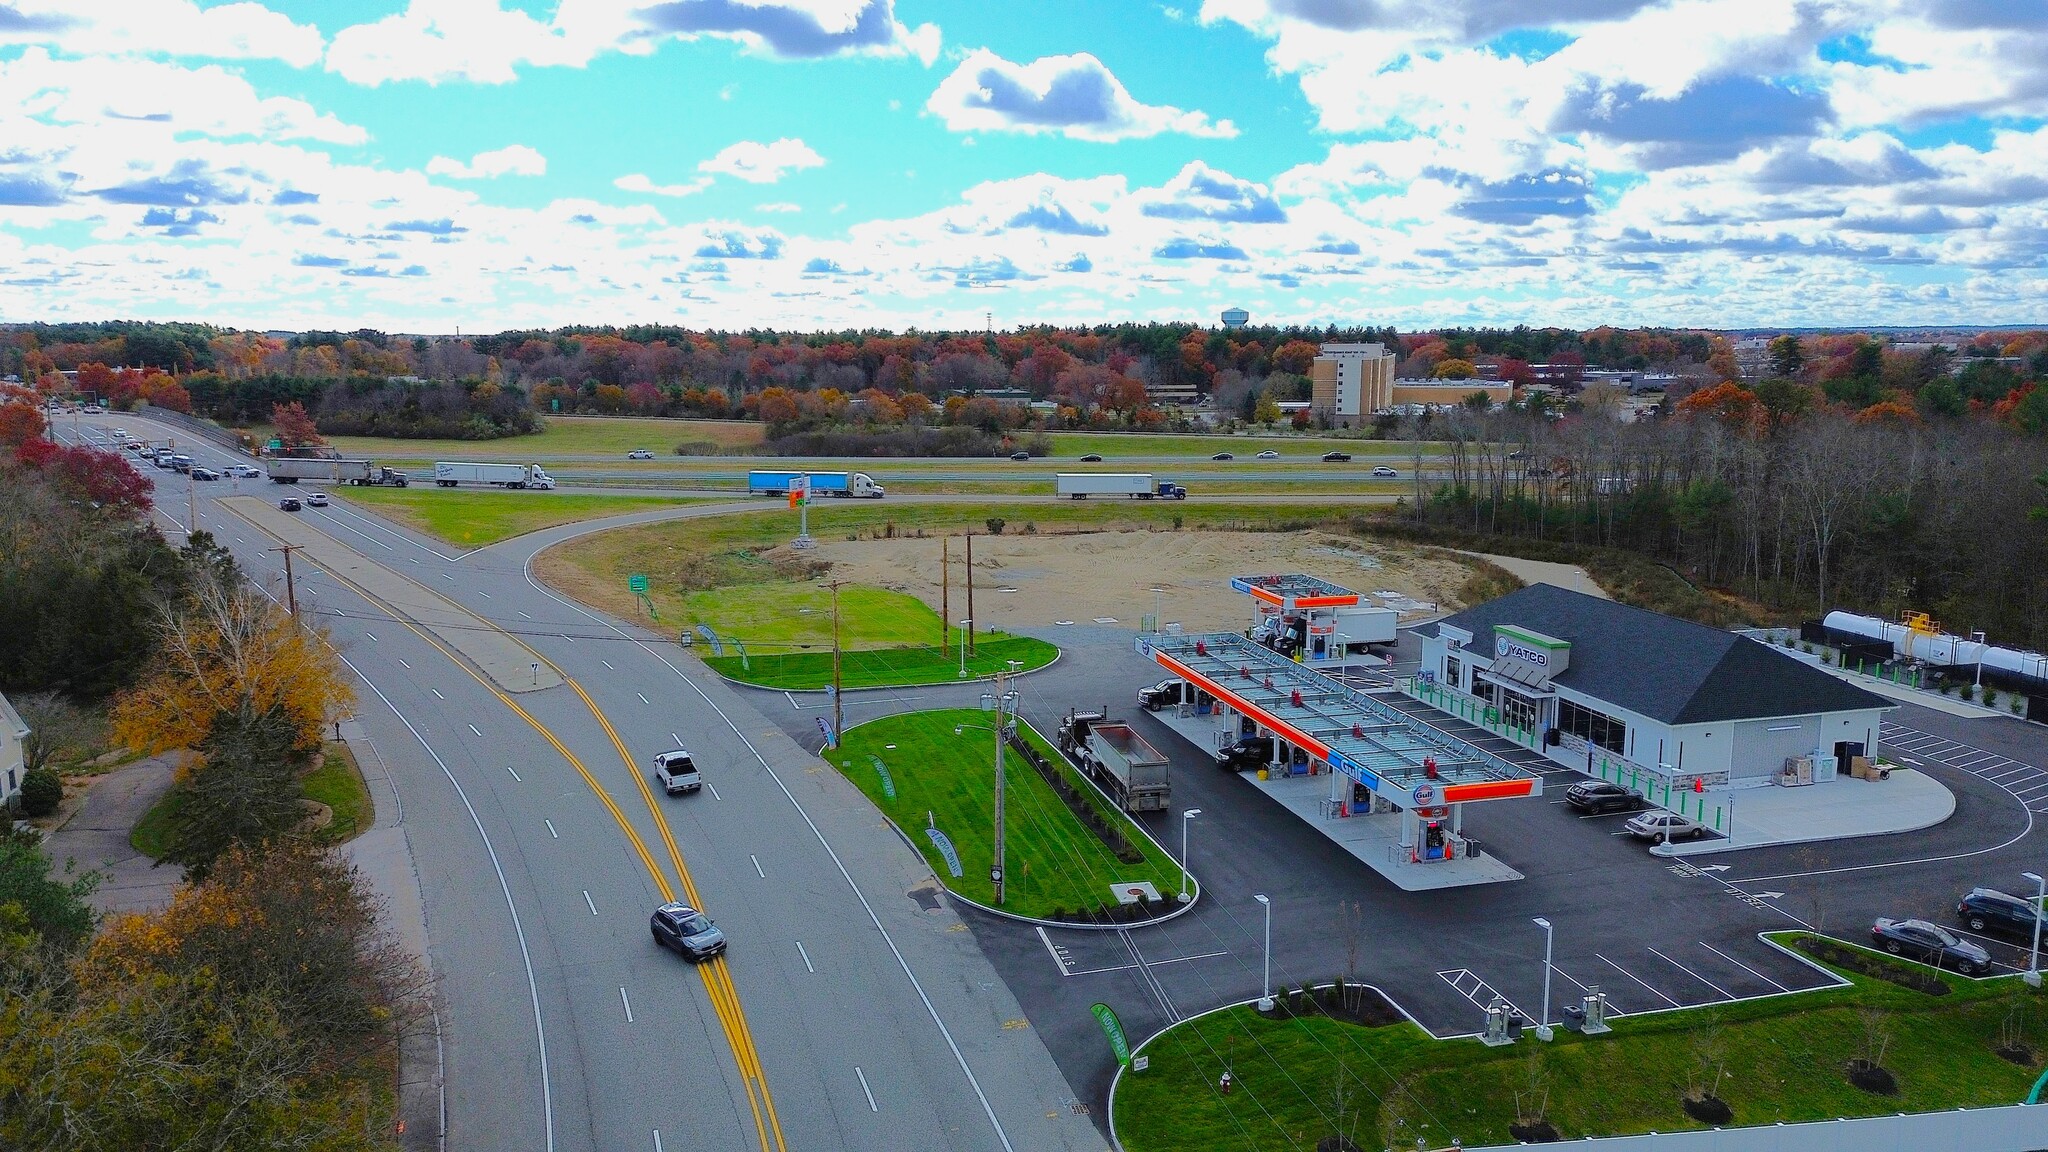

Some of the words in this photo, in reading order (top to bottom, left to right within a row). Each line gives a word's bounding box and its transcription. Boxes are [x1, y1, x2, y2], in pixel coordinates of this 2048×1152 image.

[1509, 644, 1546, 666] YATCO
[1341, 759, 1362, 782] Gulf
[1415, 790, 1434, 799] Gulf
[1724, 888, 1767, 910] DIESEL
[1054, 945, 1075, 965] STOP
[1101, 1012, 1116, 1033] NOW
[1111, 1031, 1126, 1058] OPEN
